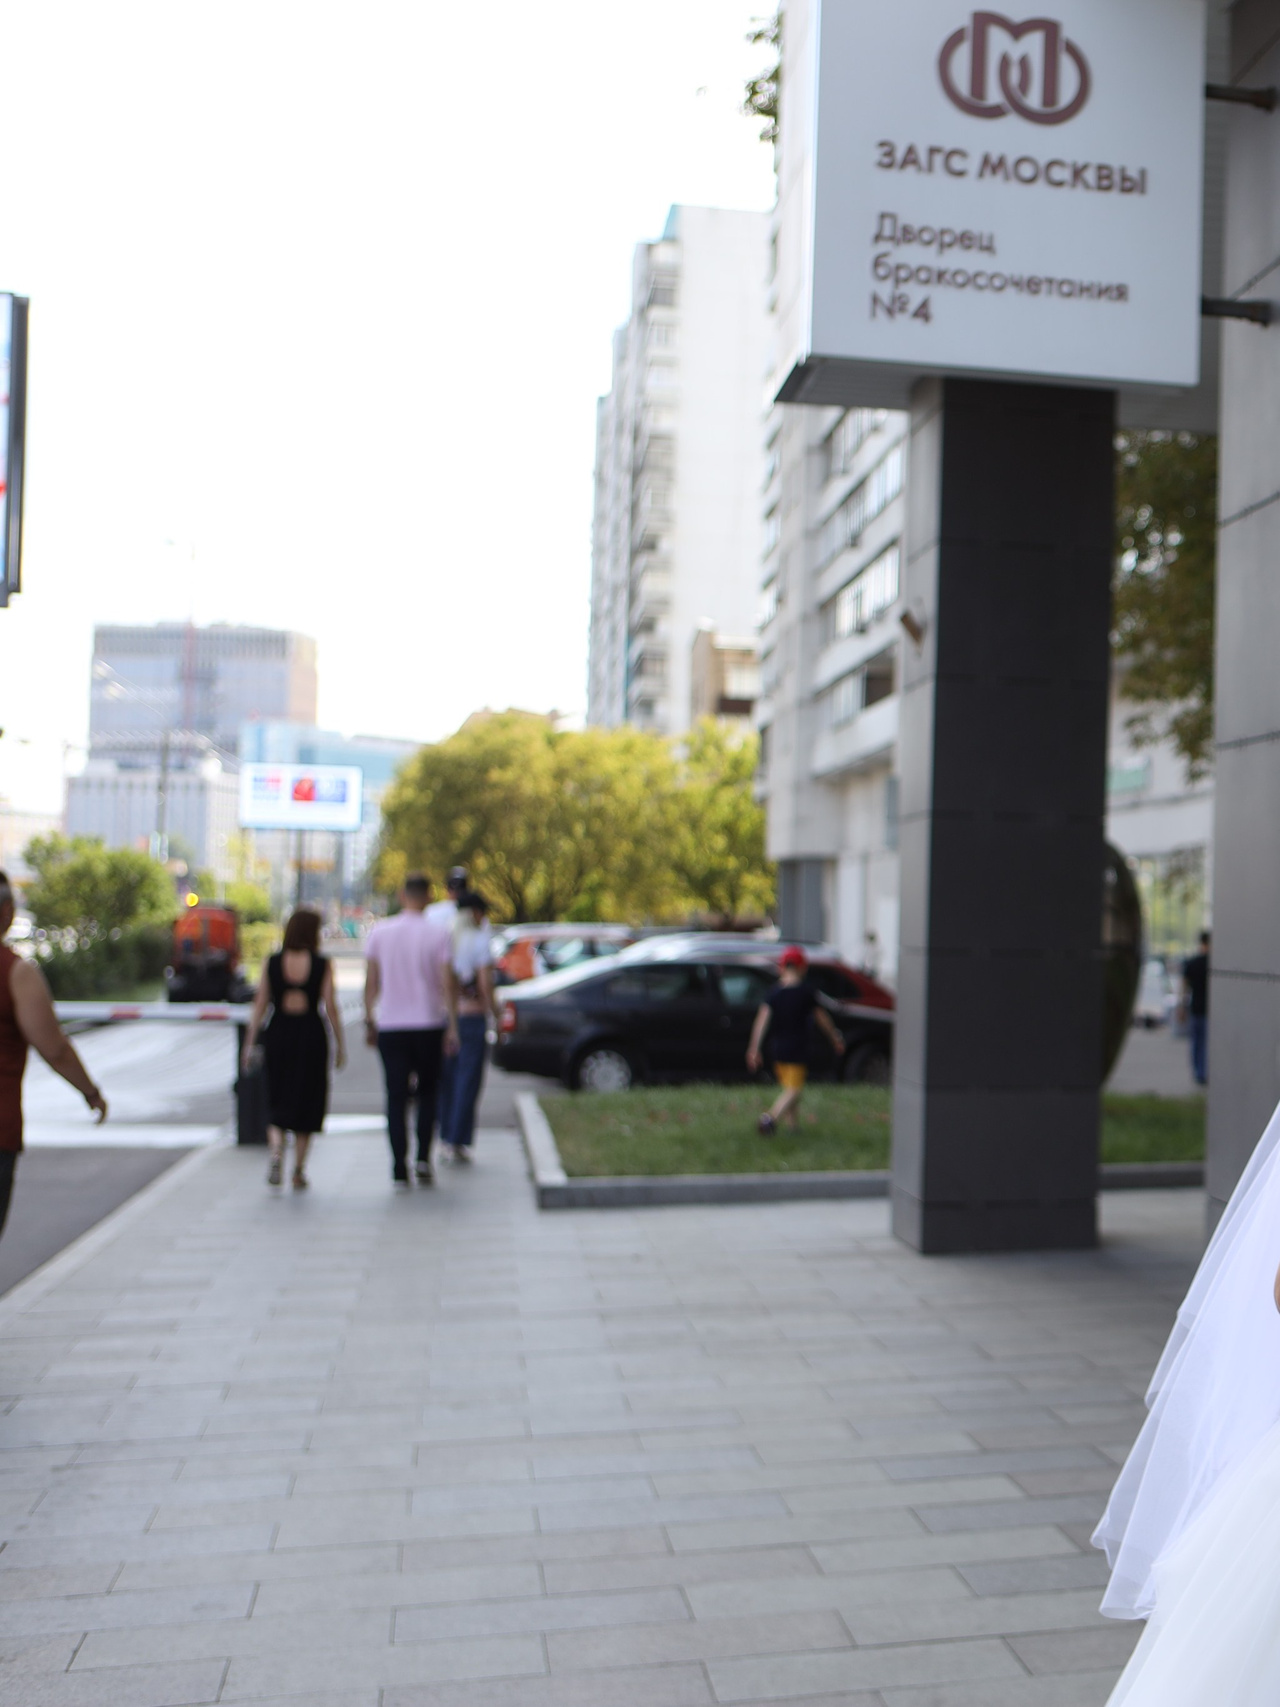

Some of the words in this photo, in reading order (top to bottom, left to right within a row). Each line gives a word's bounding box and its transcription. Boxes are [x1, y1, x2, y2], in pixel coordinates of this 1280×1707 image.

[876, 141, 968, 177] ЗАГС
[977, 152, 1148, 195] МОСКВЫ
[873, 212, 996, 255] Дворец
[872, 252, 1129, 303] бракосочетания
